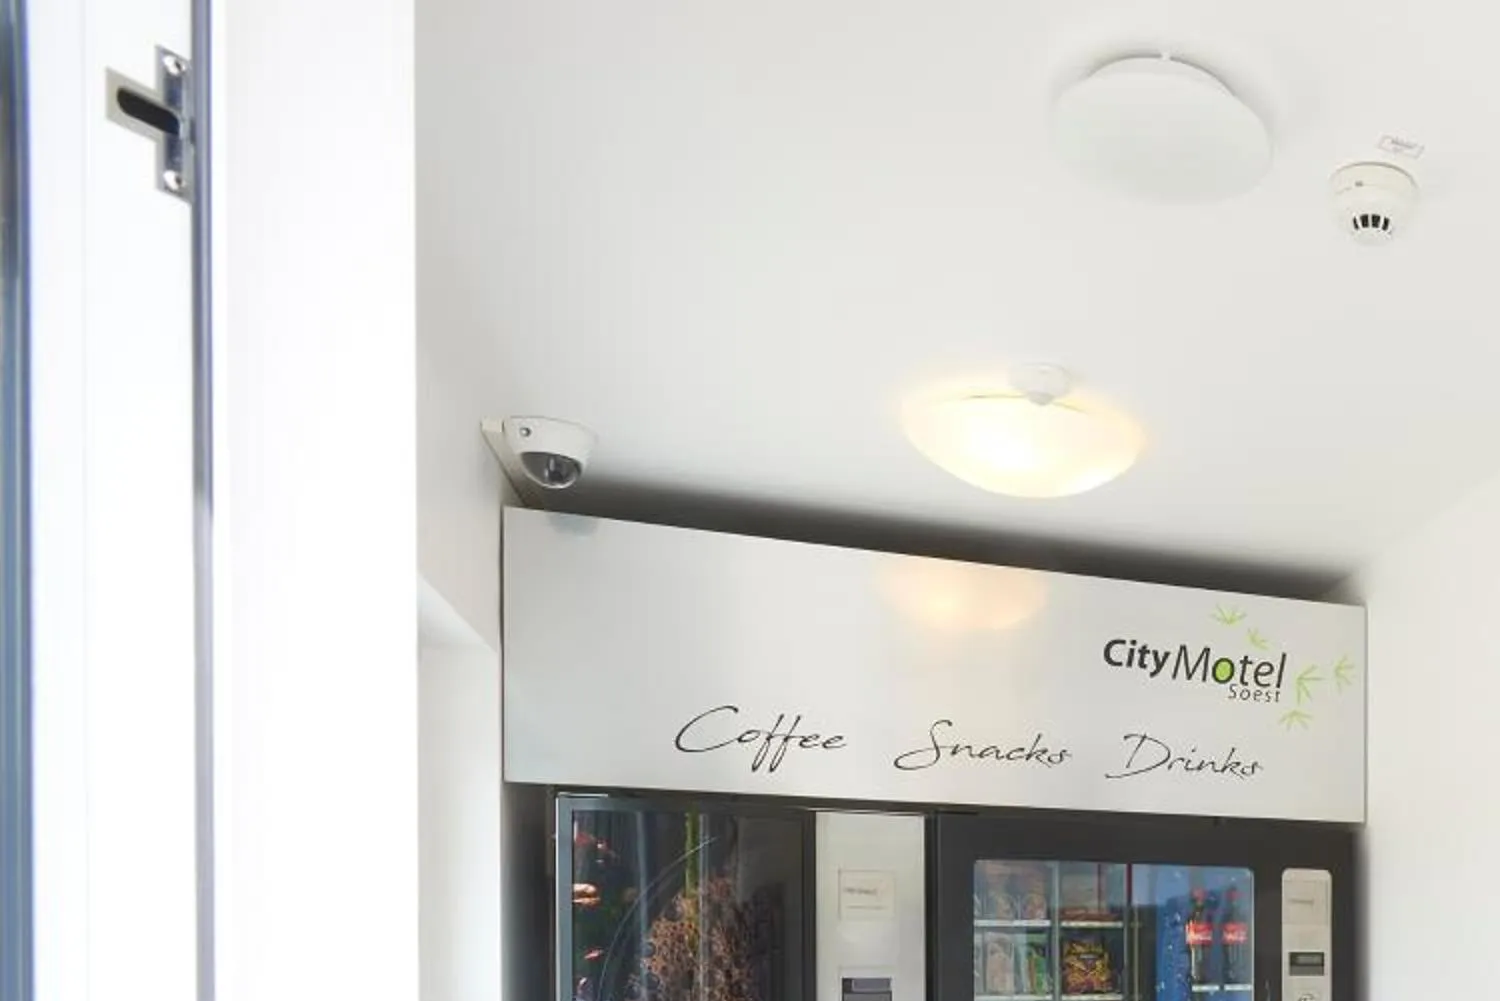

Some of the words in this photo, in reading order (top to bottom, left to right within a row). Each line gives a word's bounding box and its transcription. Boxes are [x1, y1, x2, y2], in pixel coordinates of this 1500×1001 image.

[1228, 683, 1281, 703] Soest
[674, 705, 847, 773] Coffee
[893, 719, 1072, 771] Snacks
[1104, 733, 1264, 780] Drinks
